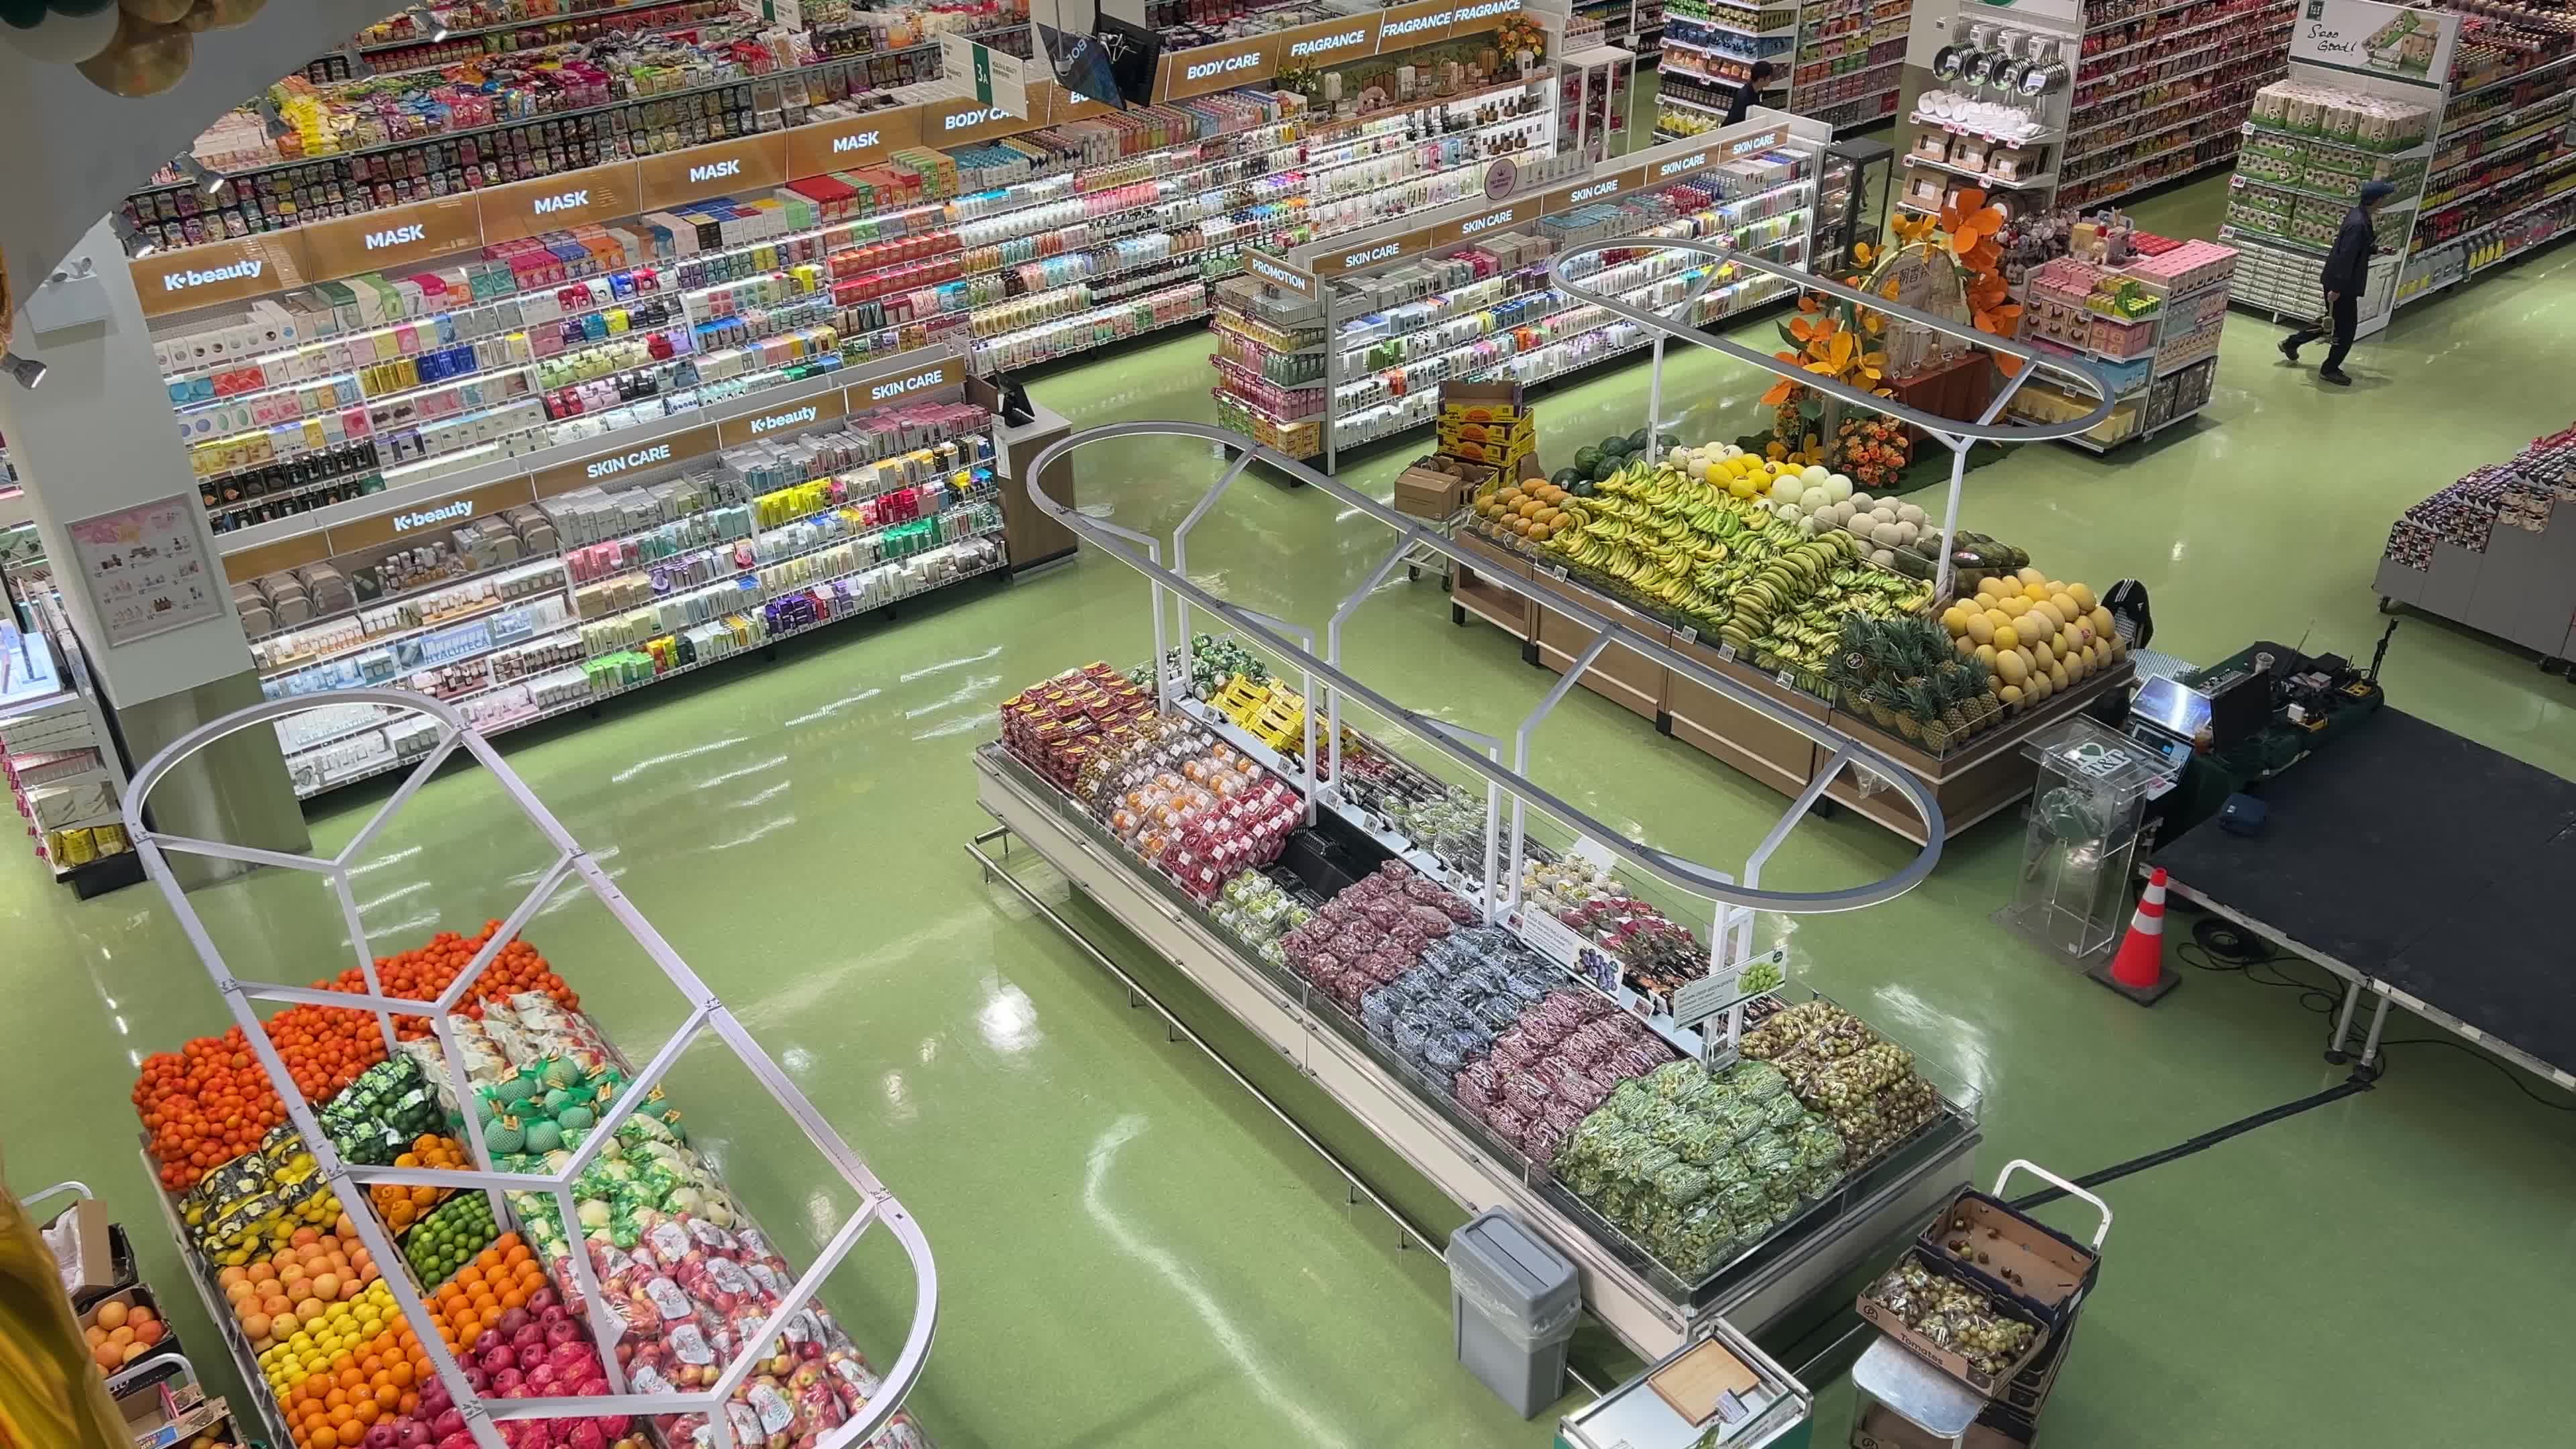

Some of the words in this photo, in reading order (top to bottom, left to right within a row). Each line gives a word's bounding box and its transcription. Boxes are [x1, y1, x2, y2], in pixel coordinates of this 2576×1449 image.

[1454, 0, 1520, 21] FRAGRANCE
[1382, 12, 1452, 37] FRAGRANCE
[1291, 30, 1364, 56] FRAGRANCE
[2318, 40, 2357, 56] Good!
[977, 64, 989, 85] 3A
[1187, 60, 1222, 79] BODY
[1223, 52, 1258, 71] CARE
[945, 109, 987, 129] BODY
[834, 131, 879, 151] MASK
[1733, 140, 1752, 155] SKIN
[1753, 133, 1776, 149] CARE
[689, 160, 740, 182] MASK
[1660, 160, 1682, 175] SKIN
[1682, 154, 1705, 170] CARE
[534, 191, 588, 214] MASK
[1571, 186, 1593, 203] SKIN
[1594, 180, 1618, 197] CARE
[1462, 217, 1485, 233] SKIN
[1486, 210, 1512, 227] CARE
[365, 225, 425, 249] MASK
[1346, 251, 1370, 267] SKIN
[1371, 244, 1399, 260] CARE
[1252, 258, 1305, 290] PROMOTION
[871, 383, 904, 400] SKIN
[906, 370, 943, 392] CARE
[586, 455, 625, 478] SKIN
[627, 445, 670, 470] CARE
[1900, 1332, 1943, 1364] Tomatoes
